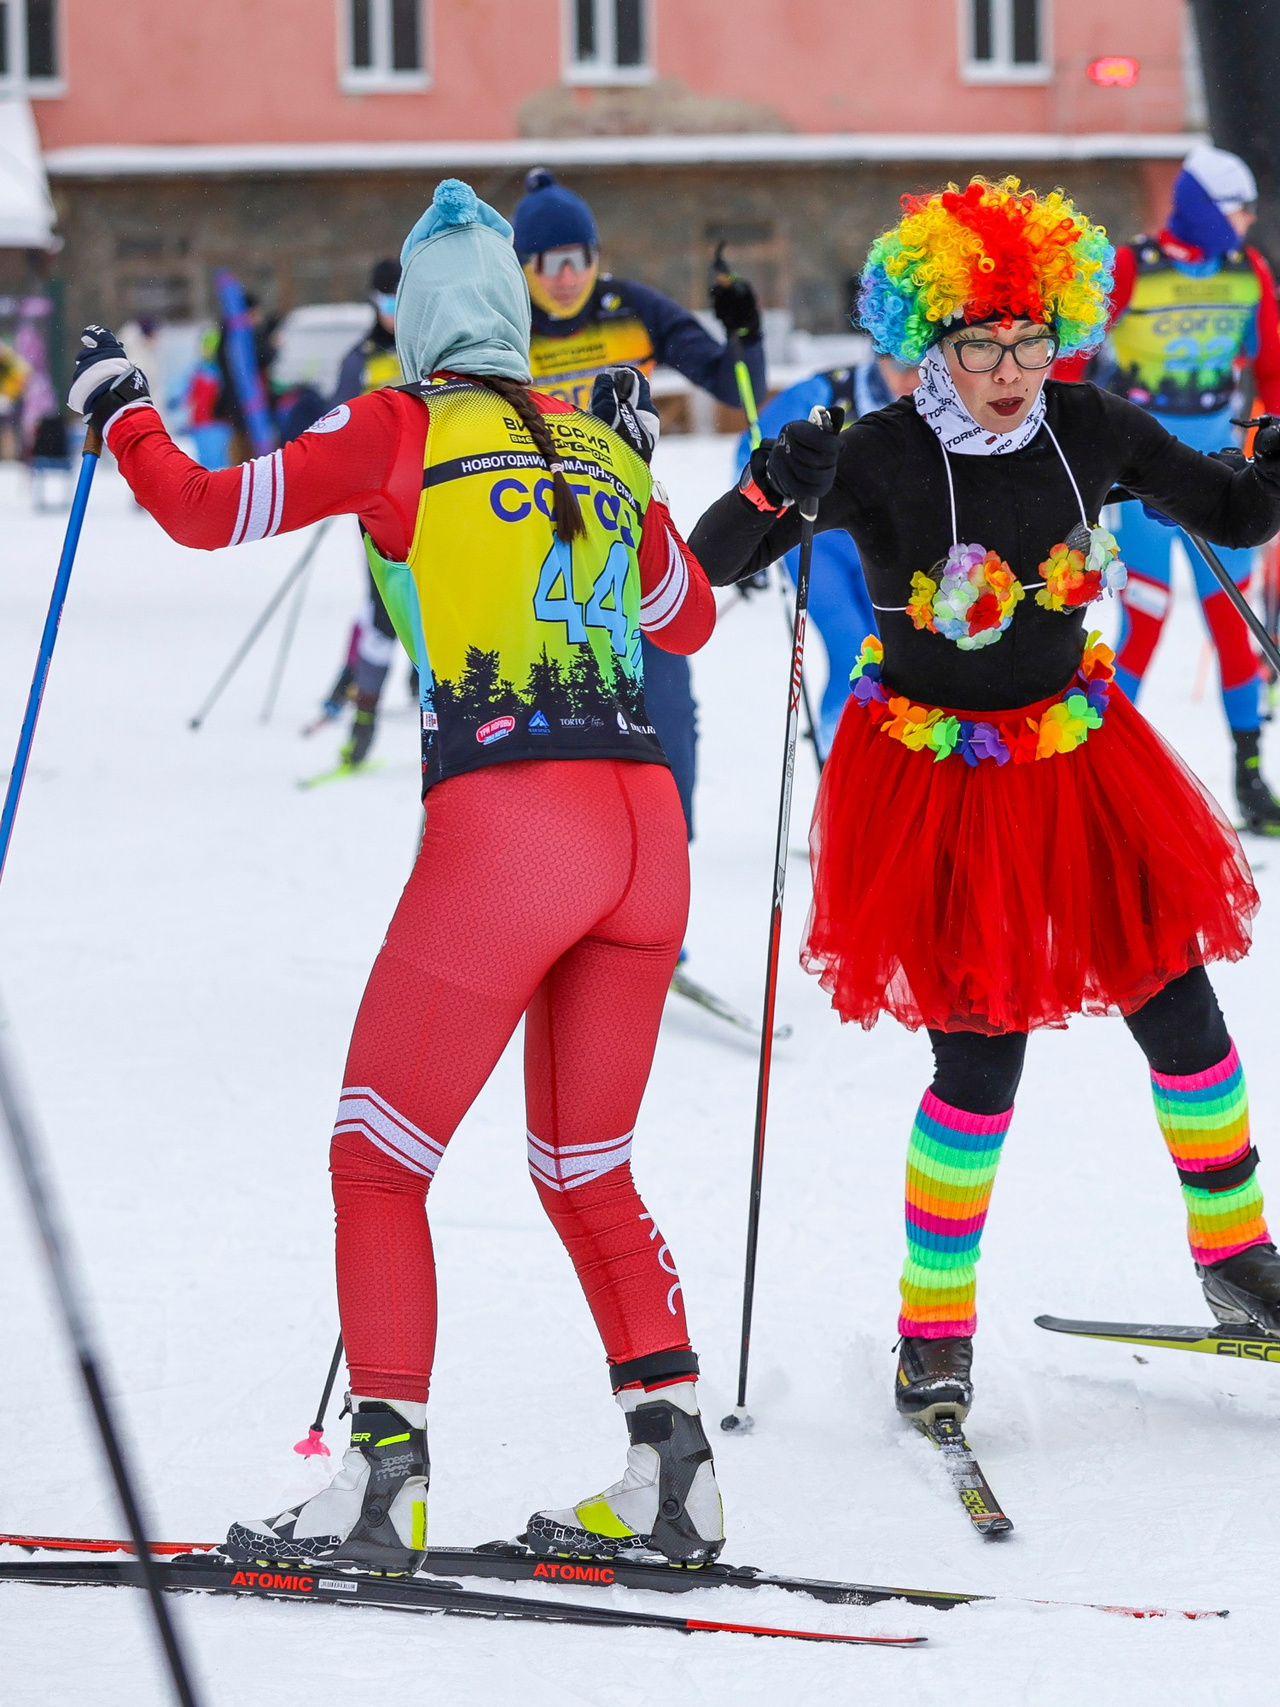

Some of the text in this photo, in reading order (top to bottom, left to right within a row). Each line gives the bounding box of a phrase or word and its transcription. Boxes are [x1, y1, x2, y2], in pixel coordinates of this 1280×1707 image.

[503, 416, 610, 454] ВИТОРИЯ
[533, 530, 630, 657] 44
[559, 717, 585, 727] TORTO
[381, 1452, 415, 1468] speed
[230, 1570, 314, 1592] ATOMIC
[532, 1562, 615, 1584] ATOMIC
